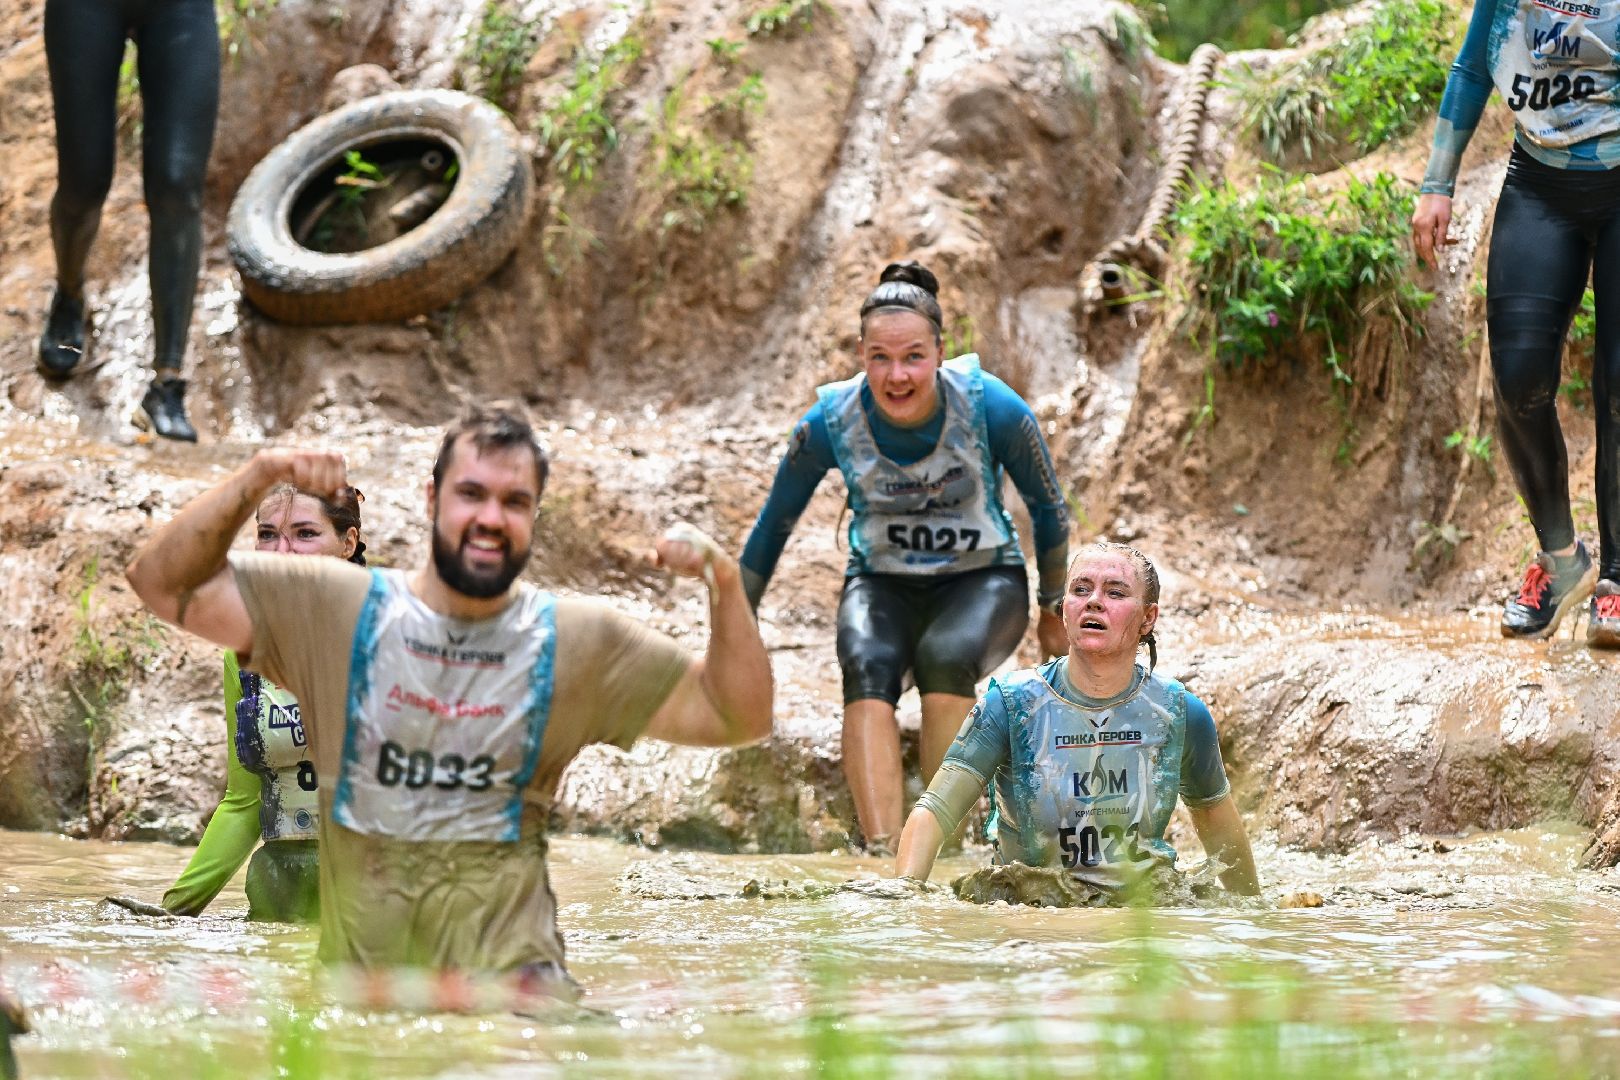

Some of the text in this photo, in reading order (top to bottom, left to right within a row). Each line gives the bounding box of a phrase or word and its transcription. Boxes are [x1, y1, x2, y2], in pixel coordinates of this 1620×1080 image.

[887, 524, 981, 552] 5027
[1055, 730, 1142, 746] ГОНКА ГЕРОЕВ
[377, 739, 496, 792] 6033
[1057, 822, 1151, 869] 5022
